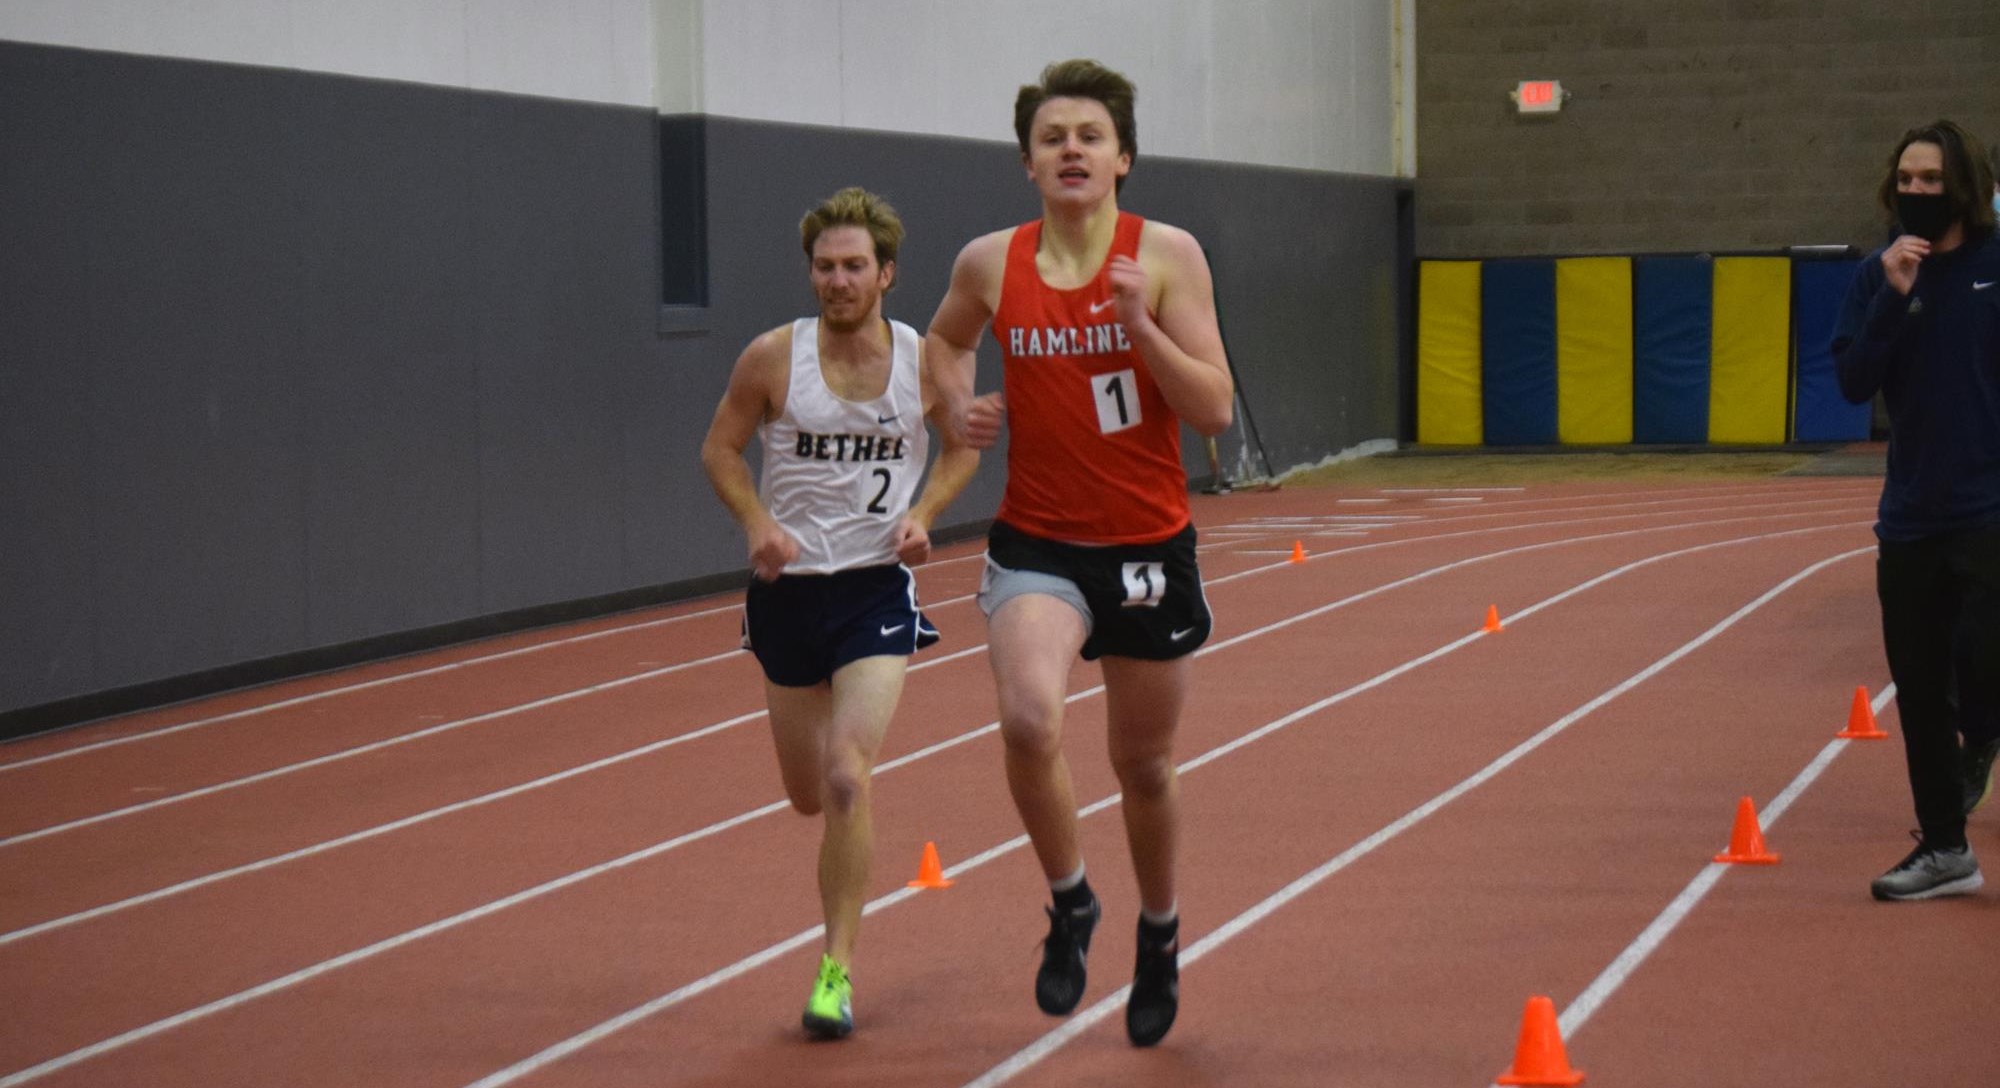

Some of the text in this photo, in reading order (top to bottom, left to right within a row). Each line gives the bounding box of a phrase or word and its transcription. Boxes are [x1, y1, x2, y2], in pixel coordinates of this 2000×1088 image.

[1010, 324, 1131, 356] HAMLINE
[1105, 376, 1128, 426] 1
[796, 431, 903, 461] BETHEL
[867, 467, 891, 514] 2
[1134, 564, 1153, 600] 1
